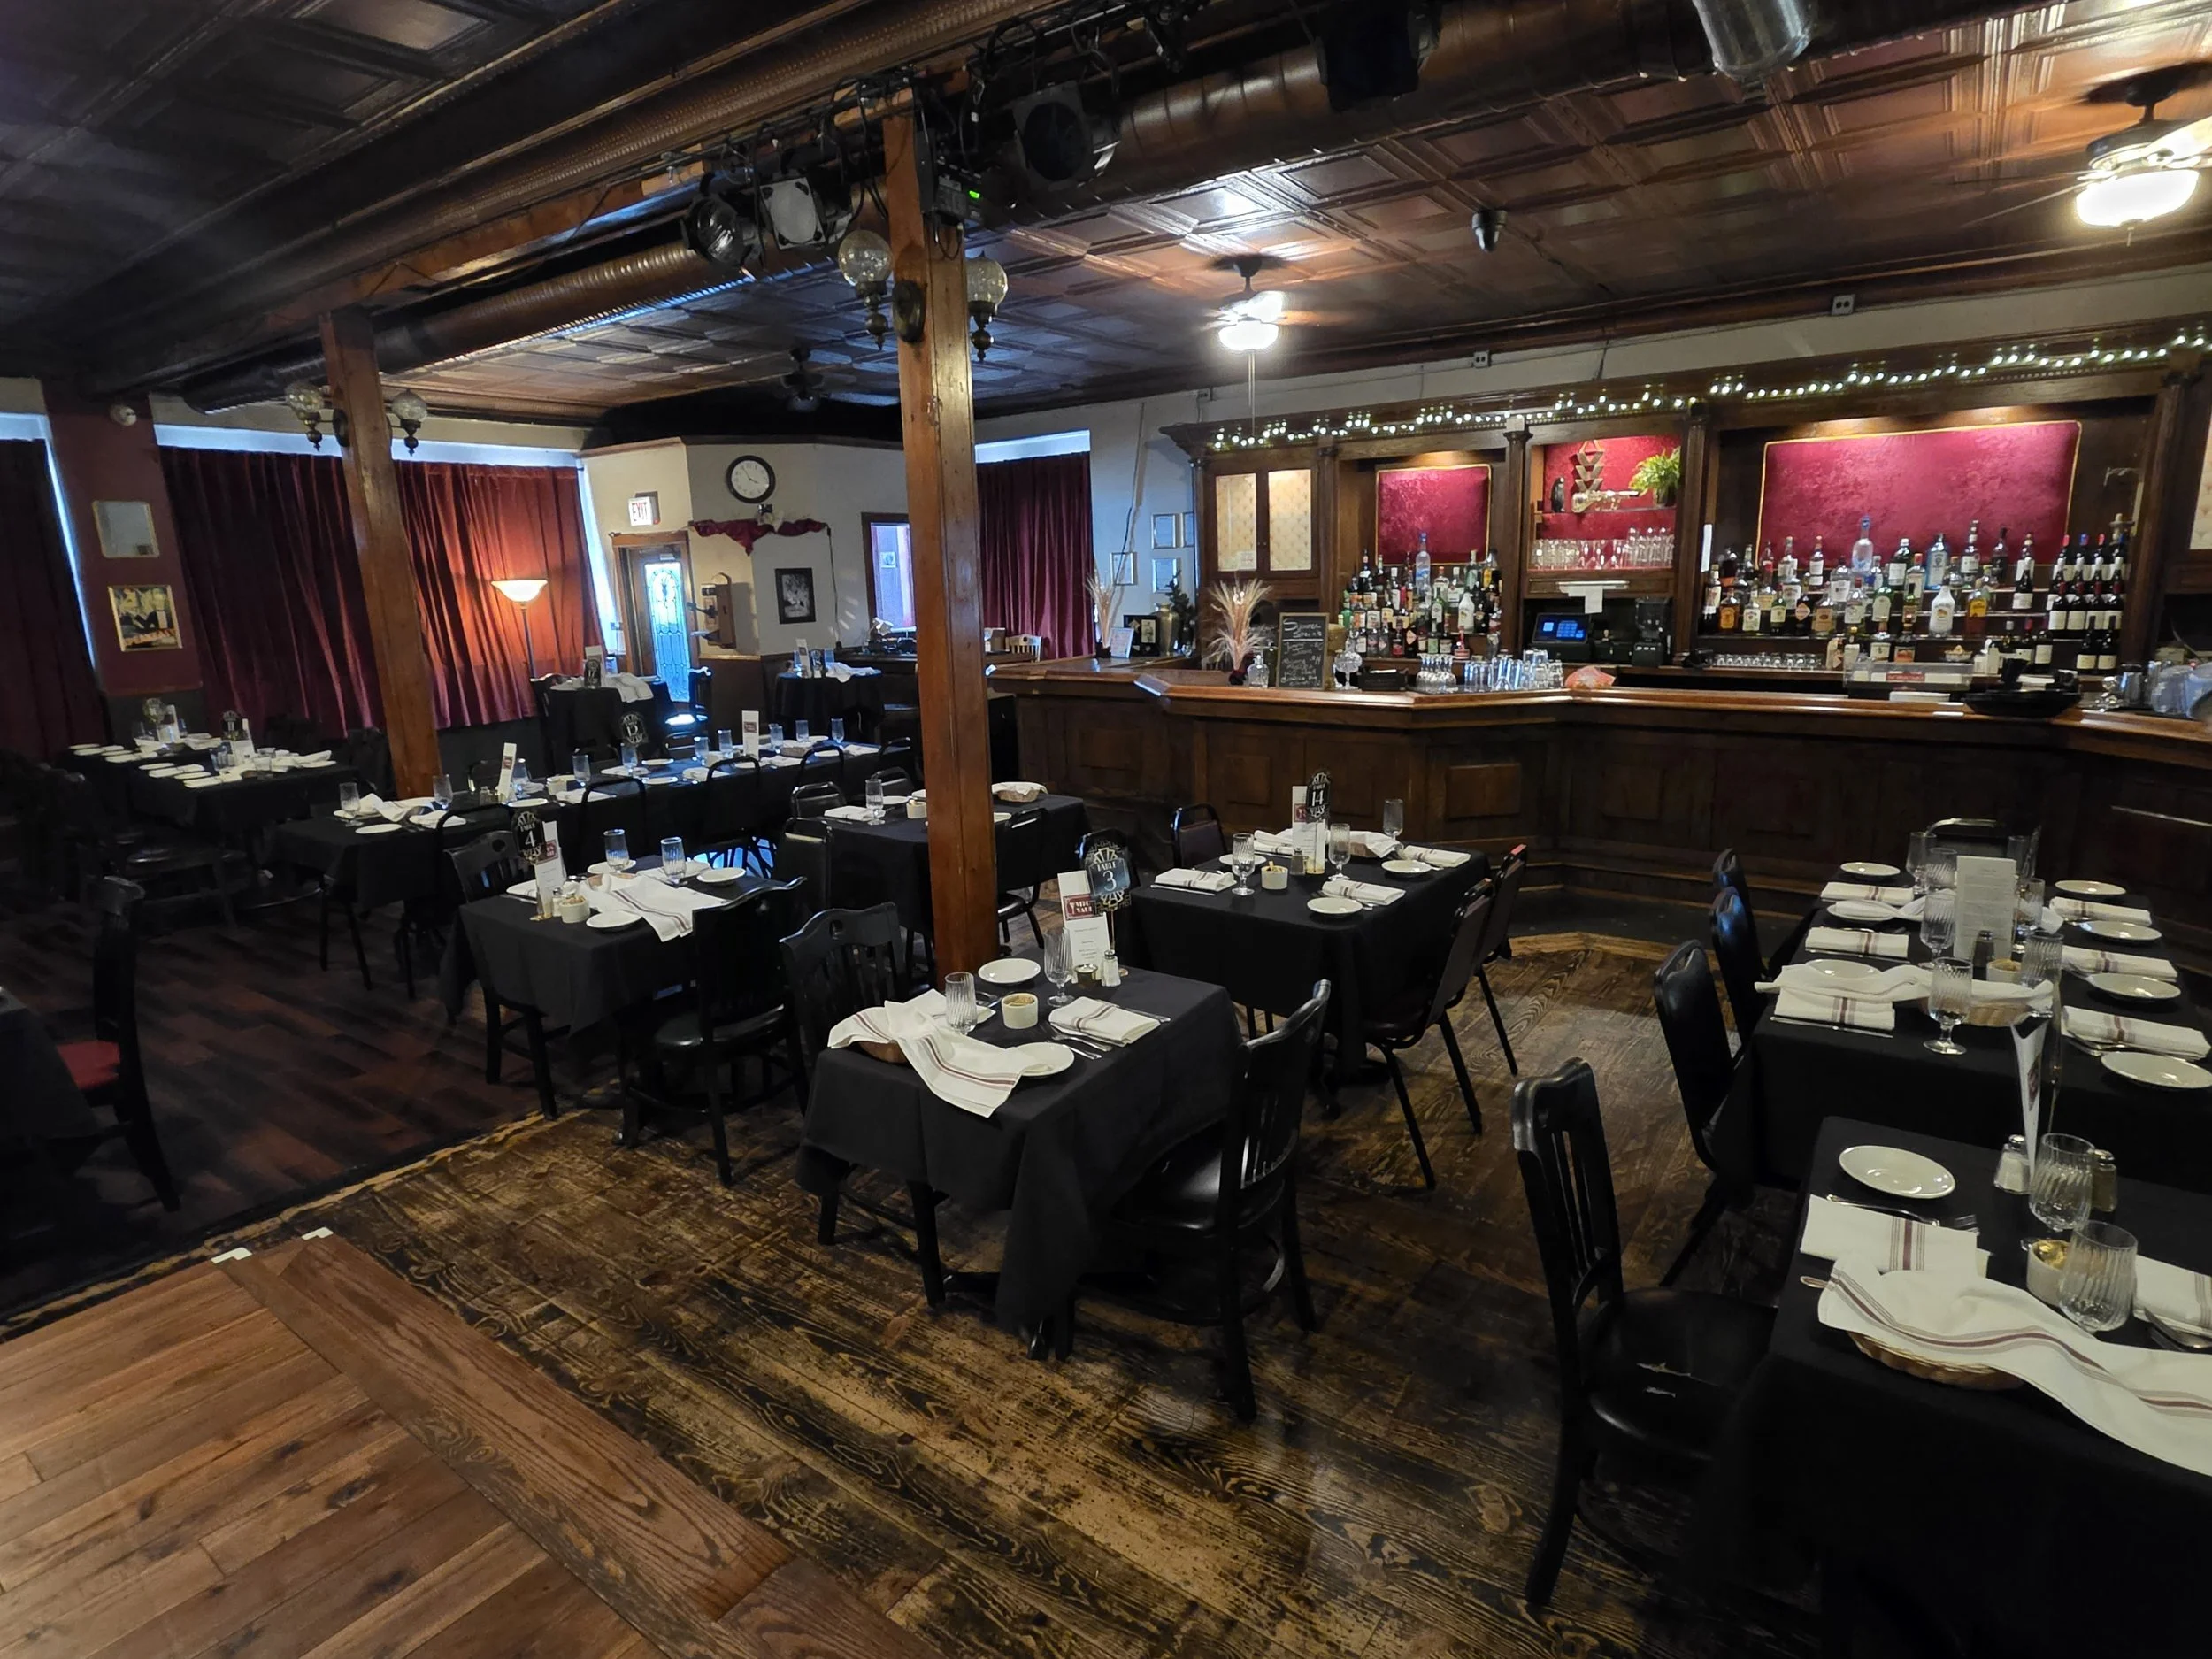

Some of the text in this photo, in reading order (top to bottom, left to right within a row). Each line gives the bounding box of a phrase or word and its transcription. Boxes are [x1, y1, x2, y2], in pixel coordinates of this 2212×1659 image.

[631, 502, 648, 522] EXIT
[1311, 790, 1325, 806] 14
[525, 830, 536, 847] 4
[1097, 861, 1116, 872] TABLE
[1102, 870, 1117, 892] 3
